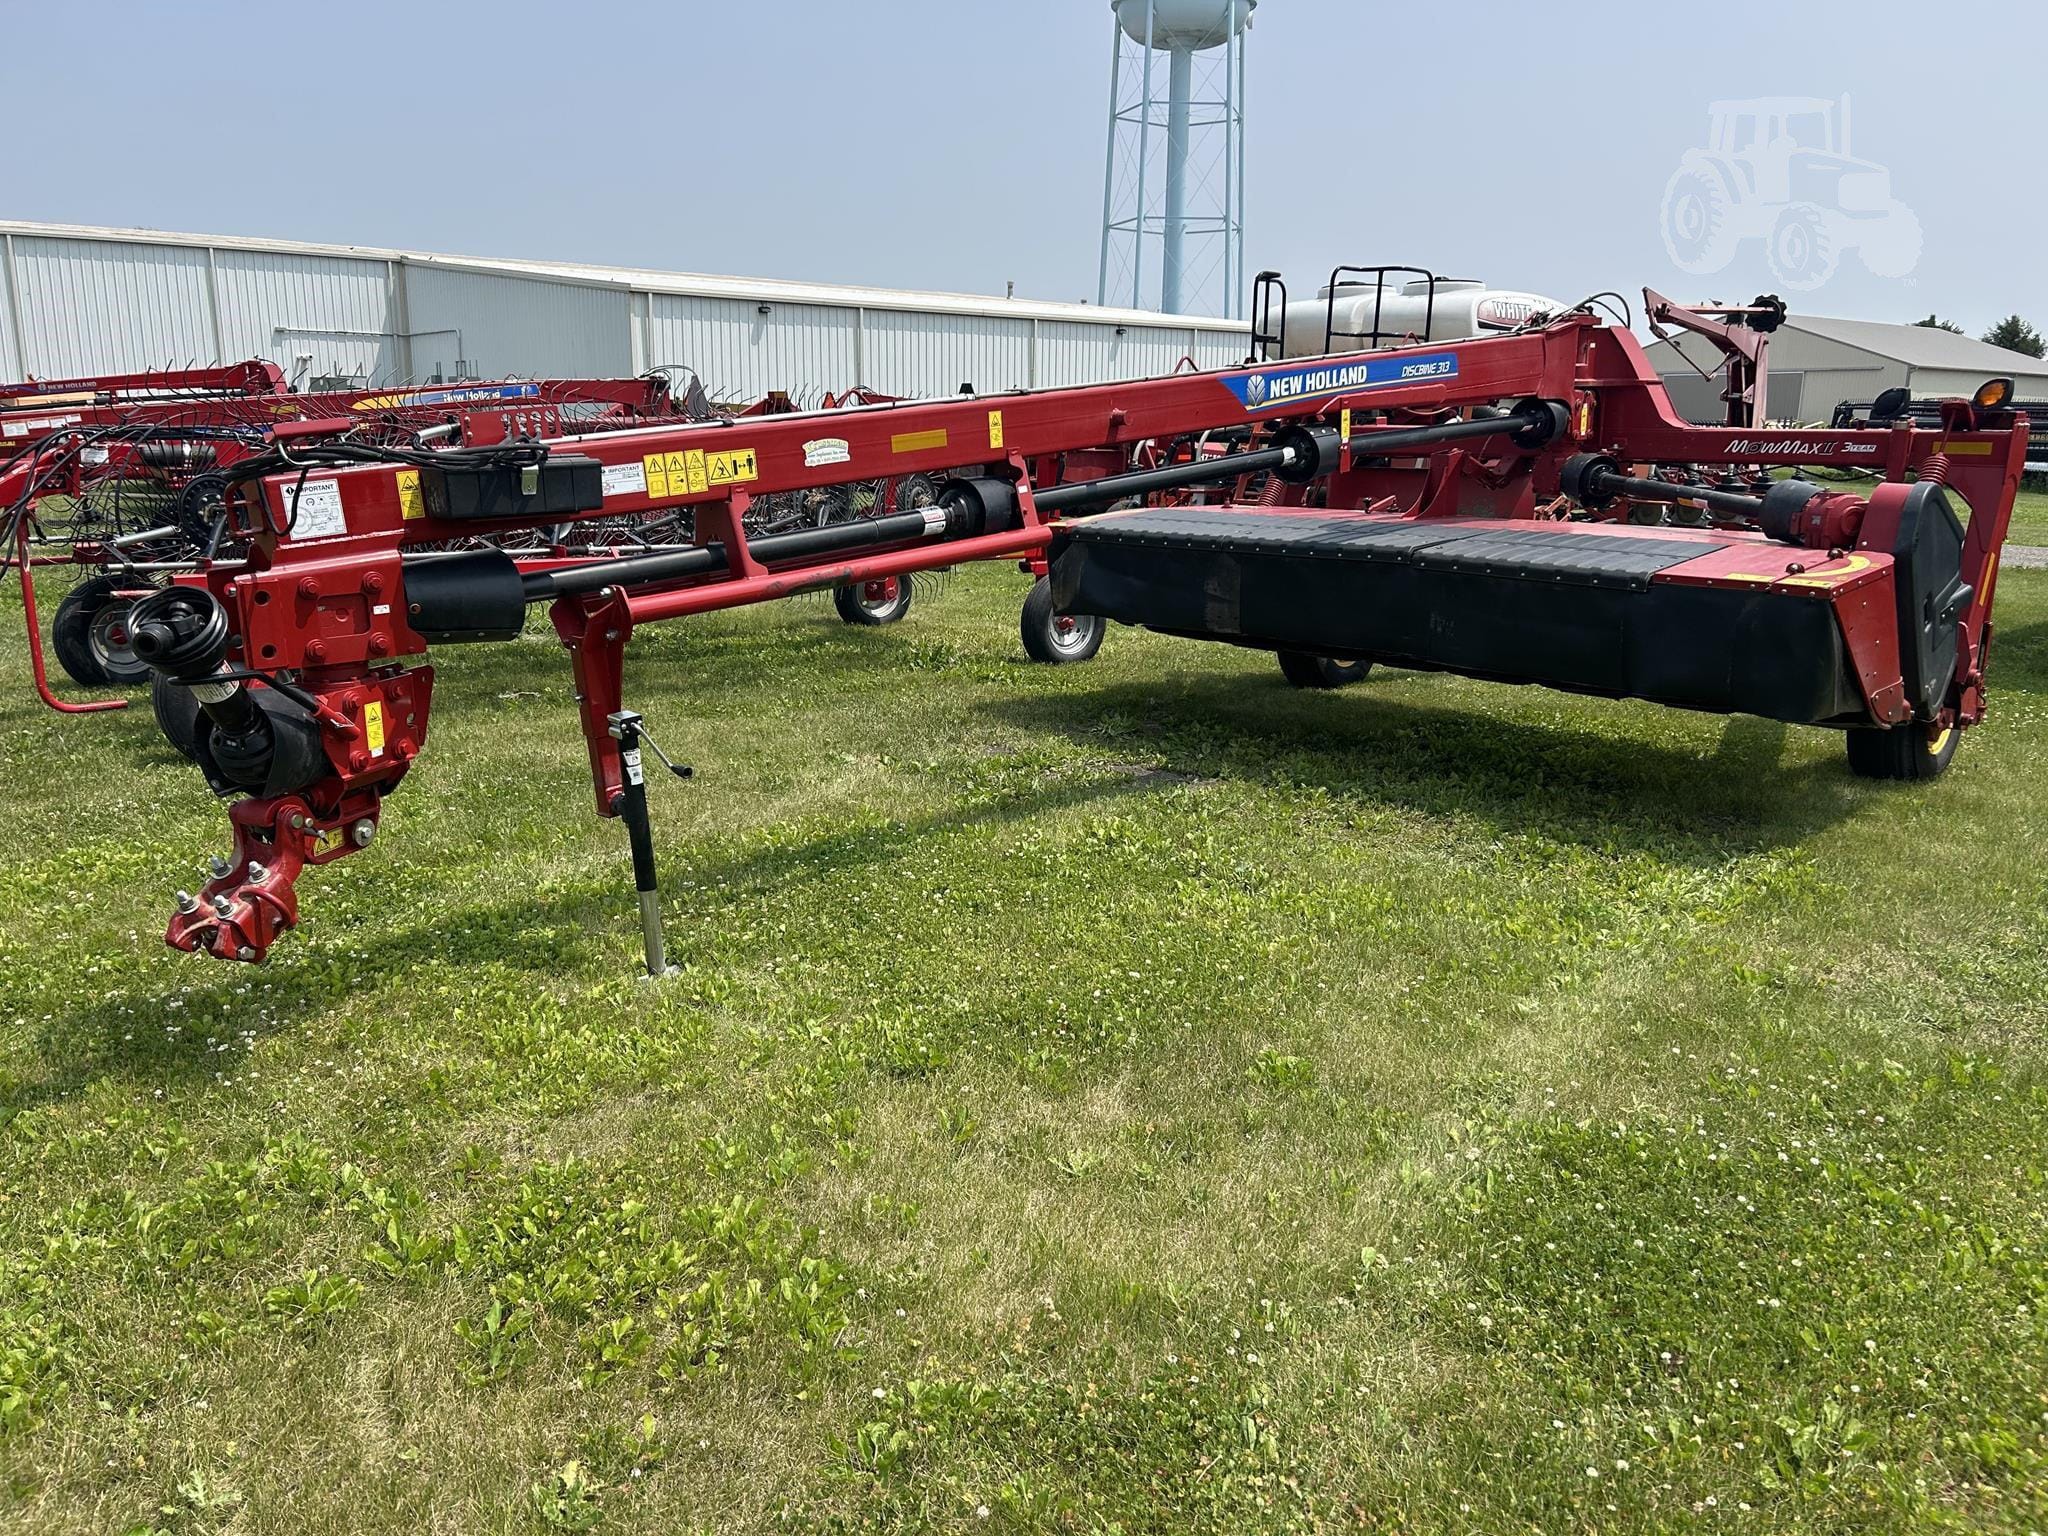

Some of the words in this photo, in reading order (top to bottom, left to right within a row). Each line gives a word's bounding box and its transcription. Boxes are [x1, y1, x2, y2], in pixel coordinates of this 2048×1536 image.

[1401, 362, 1437, 378] DISCBINE
[1437, 361, 1451, 374] 313
[65, 381, 97, 389] HOLLAND
[1269, 374, 1302, 399] NEW
[1305, 365, 1367, 392] HOLLAND
[607, 465, 641, 474] IMPORTANT
[302, 483, 335, 493] PORTANT
